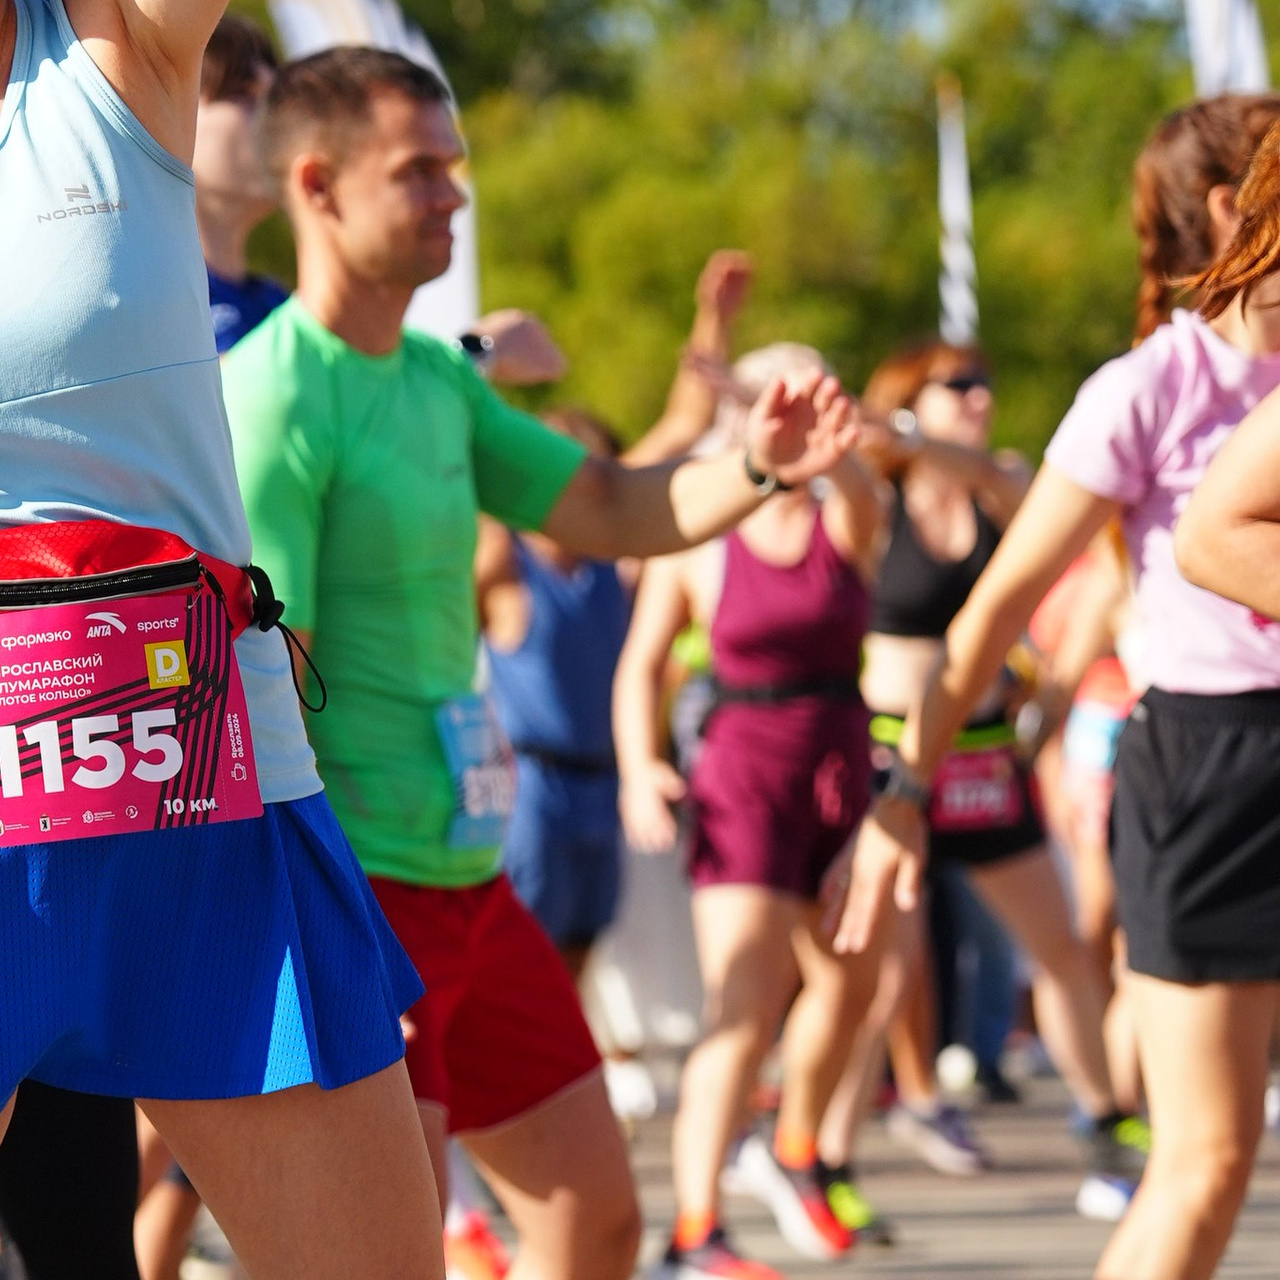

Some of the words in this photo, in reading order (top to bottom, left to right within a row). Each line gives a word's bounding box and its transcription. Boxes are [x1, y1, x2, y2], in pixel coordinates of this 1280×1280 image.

[1, 630, 71, 651] фармэко
[87, 625, 111, 639] ANTA
[154, 648, 180, 677] D
[39, 688, 92, 702] КОЛЬЦО»
[227, 713, 238, 758] Ярославль
[232, 713, 245, 758] 08.09.2024
[163, 798, 185, 815] 10
